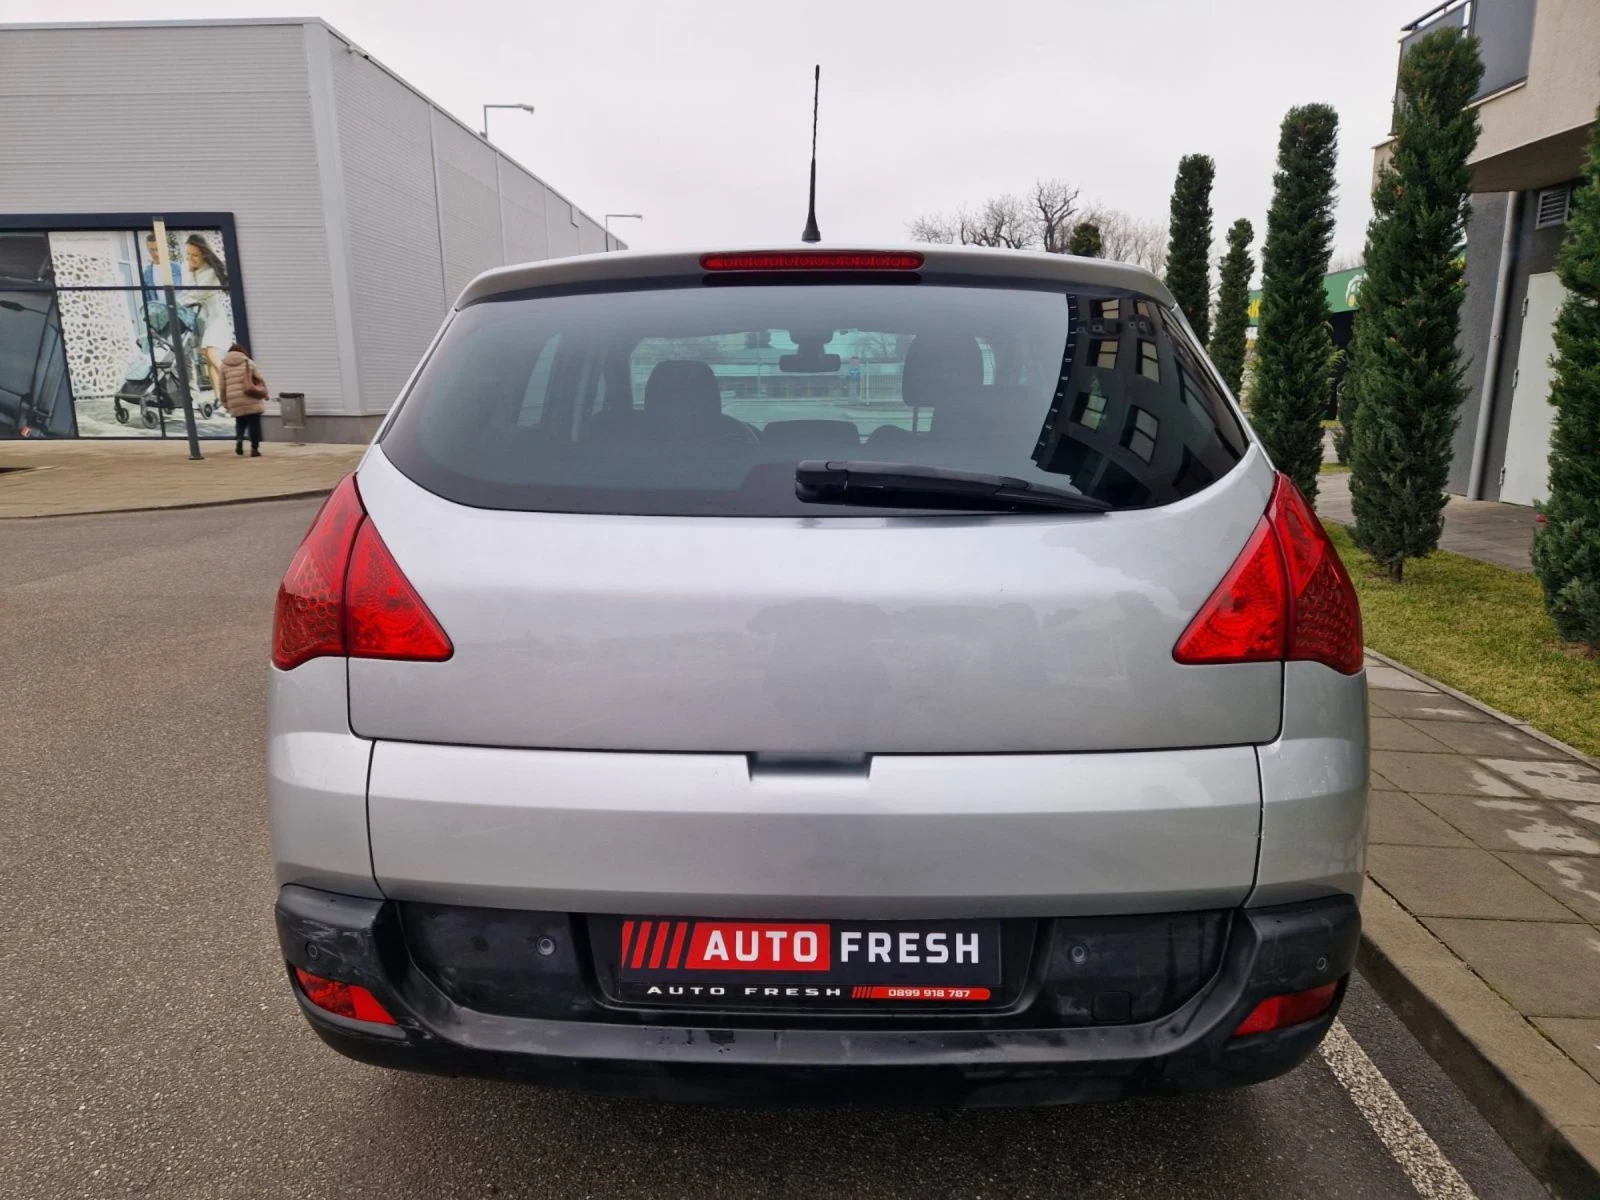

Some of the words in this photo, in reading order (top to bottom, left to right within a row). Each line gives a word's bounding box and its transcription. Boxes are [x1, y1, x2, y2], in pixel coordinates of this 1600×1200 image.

[703, 930, 818, 962] AUTO
[840, 931, 979, 964] FRESH
[647, 986, 725, 996] AUTO
[744, 987, 841, 996] FRESH
[888, 989, 920, 997] 0899
[923, 989, 945, 997] 918
[948, 989, 971, 998] 787
